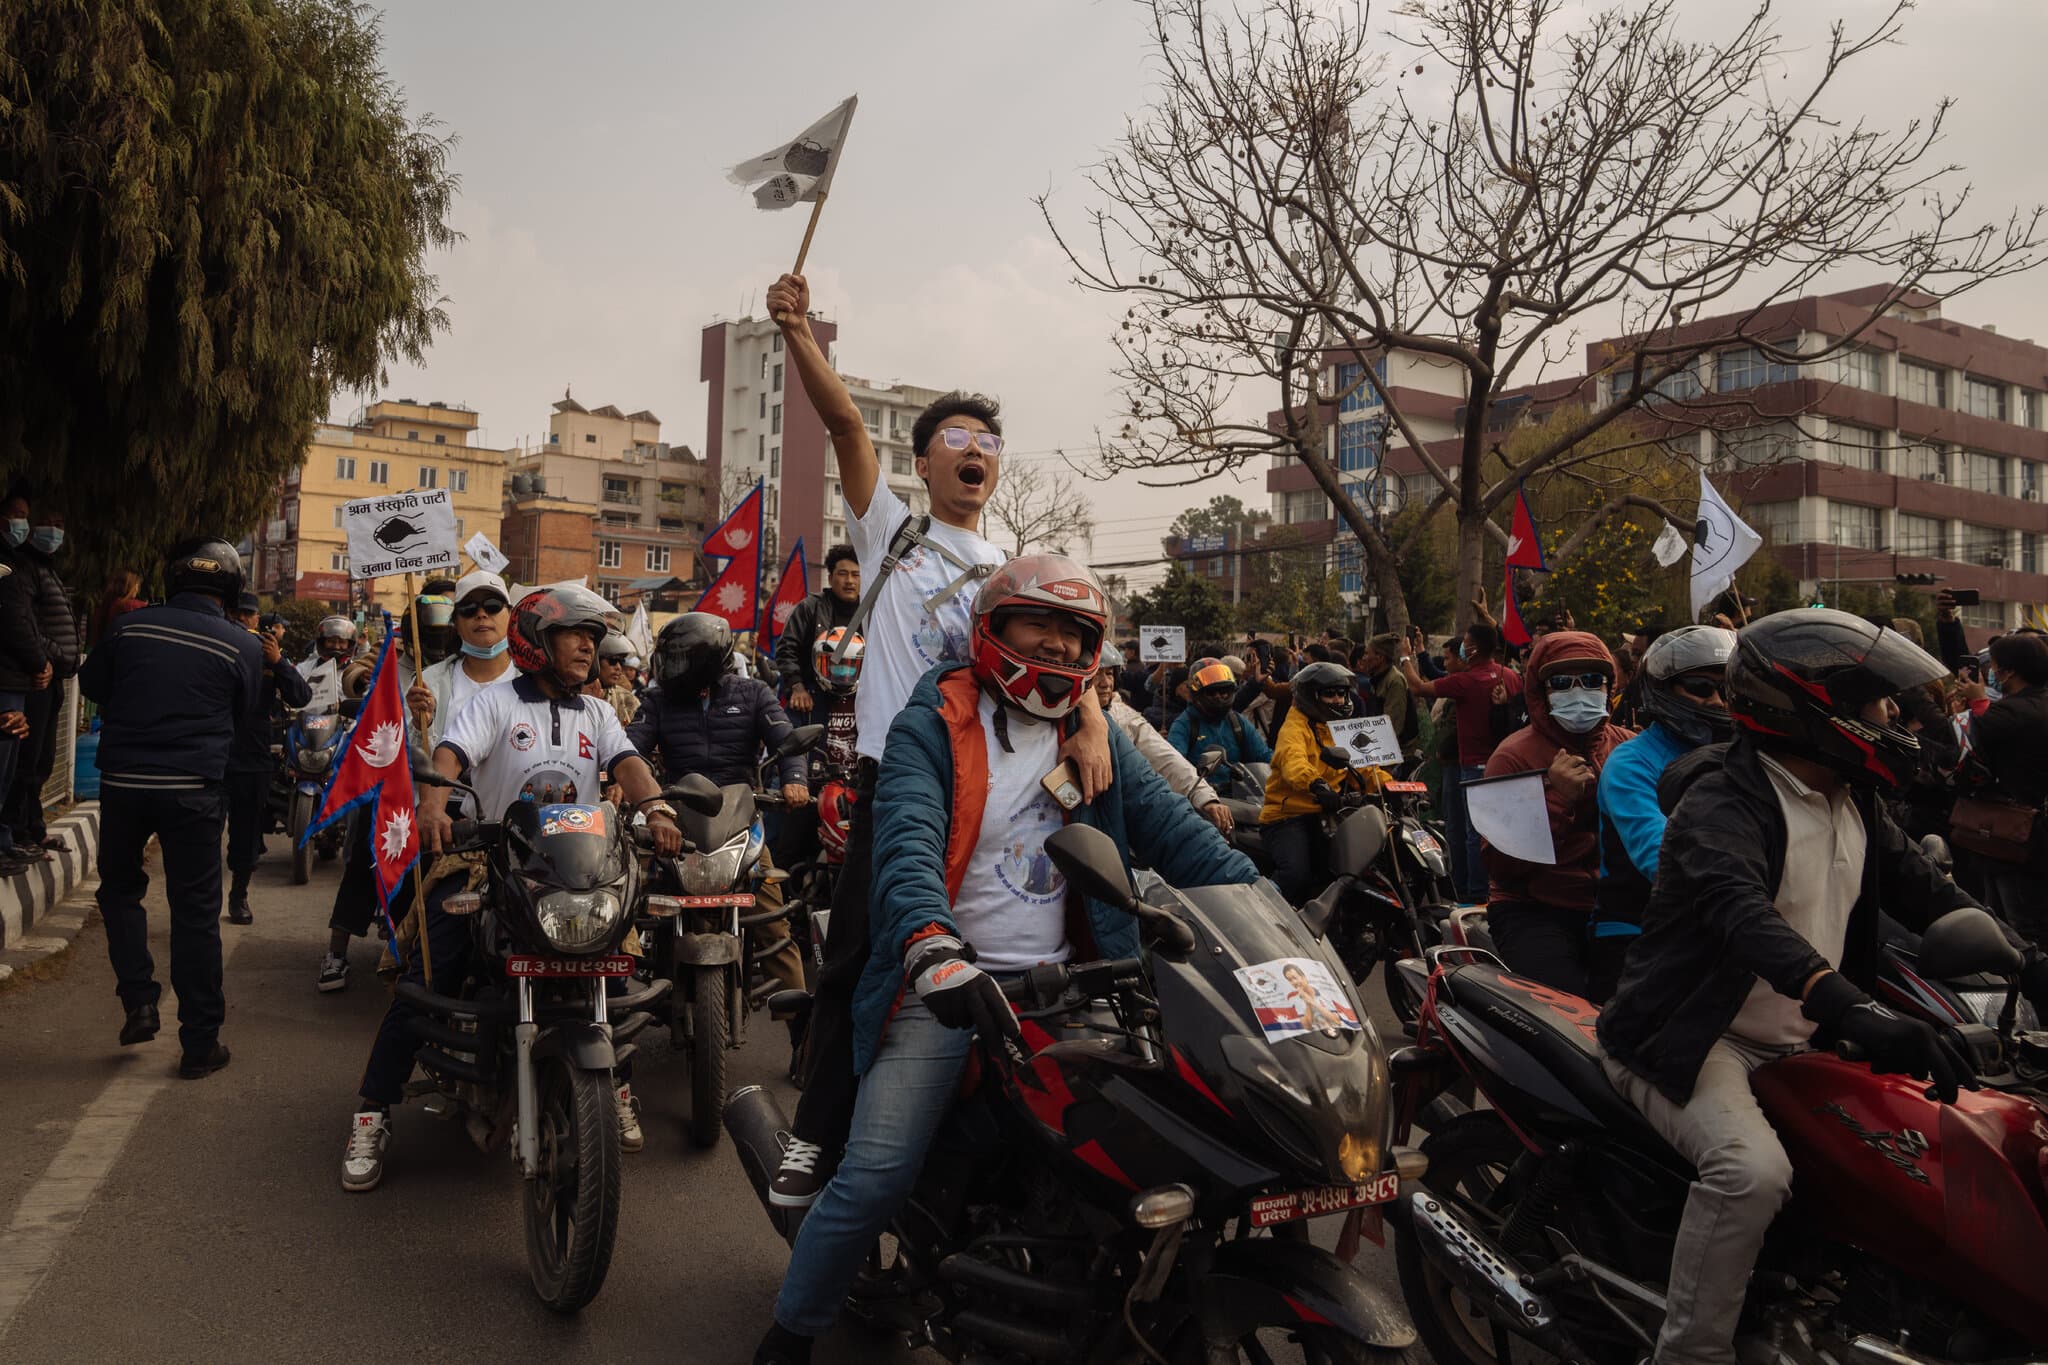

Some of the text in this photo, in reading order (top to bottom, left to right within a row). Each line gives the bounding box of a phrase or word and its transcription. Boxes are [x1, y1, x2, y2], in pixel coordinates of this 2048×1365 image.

[348, 491, 446, 516] श्रम संस्कृति पार्टी
[361, 550, 451, 576] चुनाव चिन्ह माटो
[1260, 1208, 1291, 1224] प्रदेश
